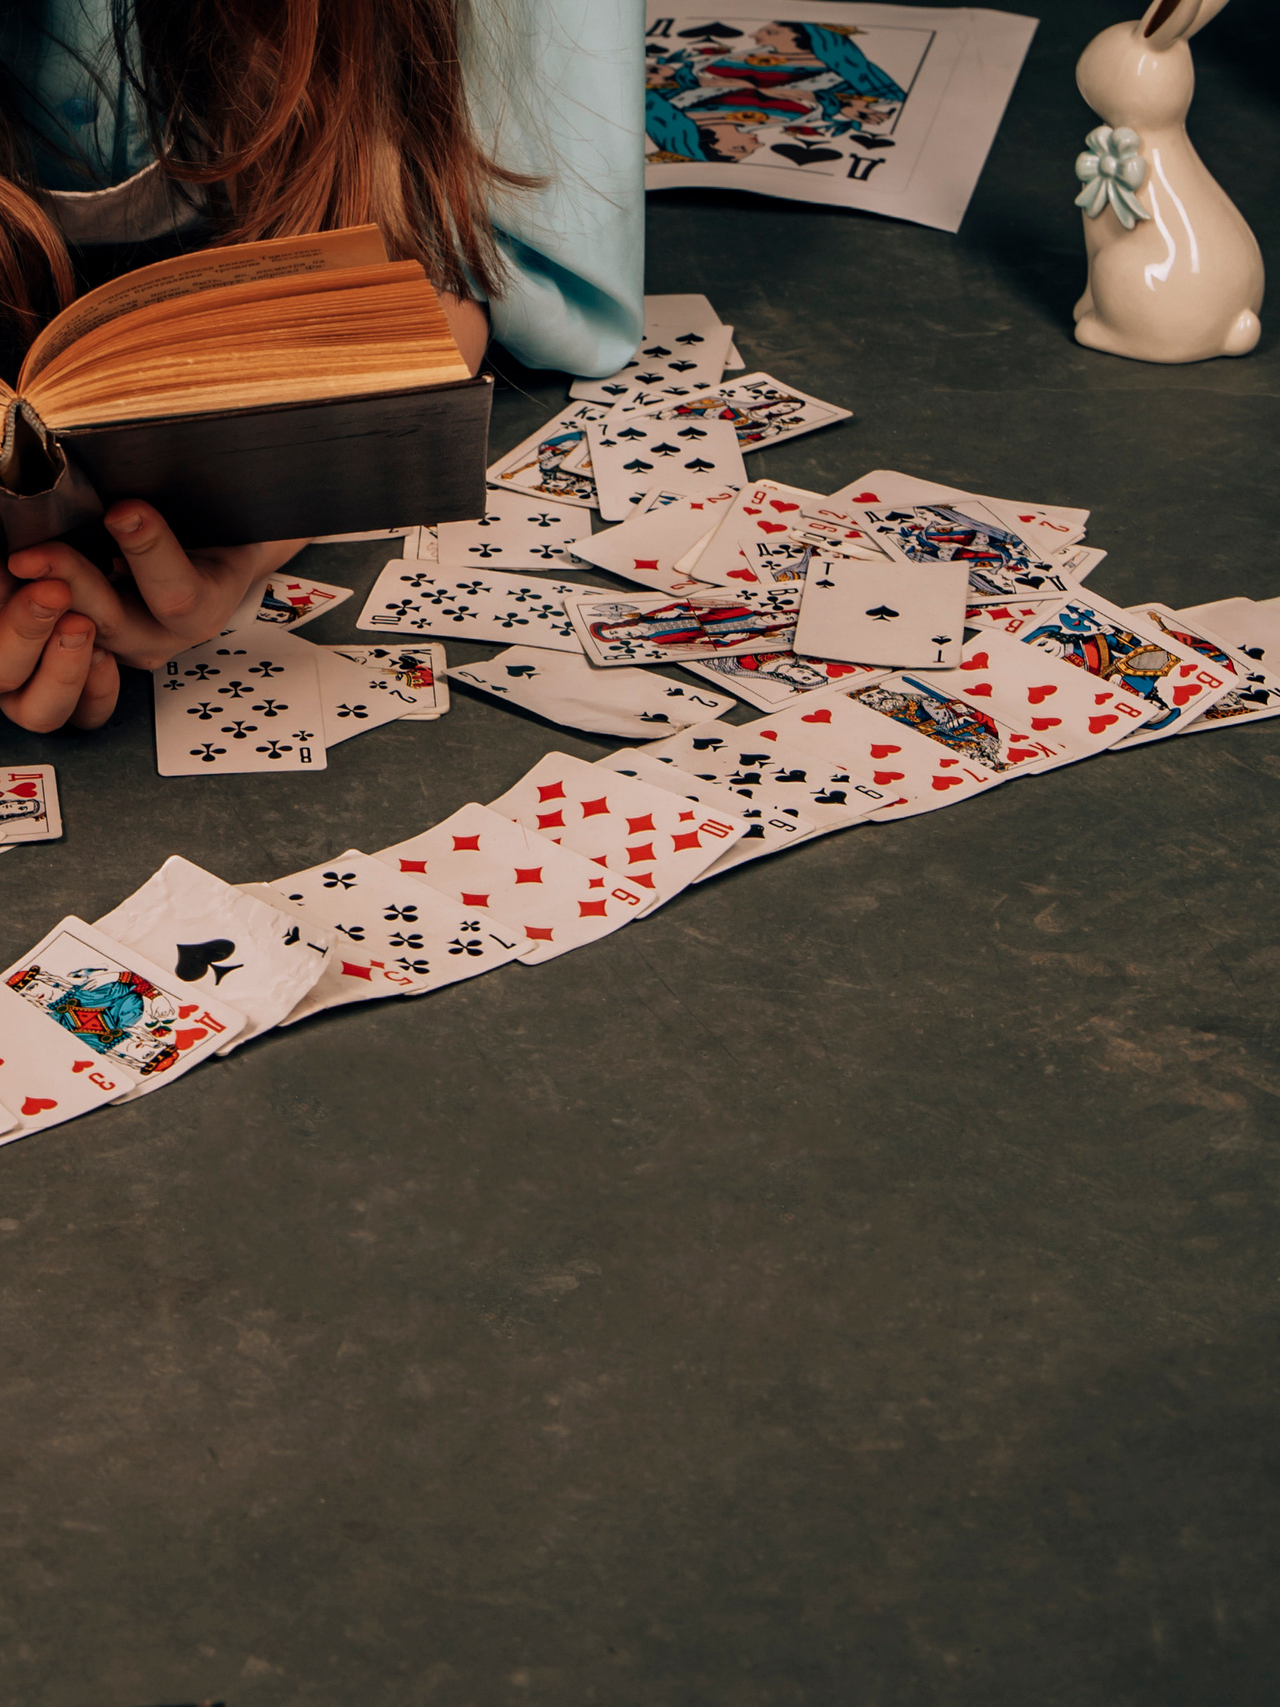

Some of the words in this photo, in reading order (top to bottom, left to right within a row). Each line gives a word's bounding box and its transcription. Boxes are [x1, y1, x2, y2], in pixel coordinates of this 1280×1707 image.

[646, 19, 674, 38] Д
[847, 154, 885, 181] Д
[741, 381, 768, 392] Д
[574, 406, 595, 419] К
[598, 424, 608, 436] 7
[707, 493, 732, 503] 2
[752, 491, 766, 504] 9
[817, 510, 847, 521] 2
[864, 511, 884, 523] Д
[1040, 521, 1069, 532] 2
[757, 543, 774, 557] Д
[823, 561, 835, 575] Т
[1046, 576, 1067, 591] Д
[305, 589, 336, 601] Д
[370, 614, 403, 625] 10
[932, 649, 946, 664] Т
[167, 662, 178, 675] 8
[458, 672, 486, 685] 2
[389, 690, 417, 703] 2
[689, 696, 718, 707] 2
[1113, 703, 1141, 720] 8
[300, 748, 311, 763] 8
[963, 769, 988, 782] 7
[699, 819, 734, 838] 10
[489, 934, 516, 949] 7
[307, 943, 328, 957] Т
[384, 969, 412, 985] 5
[192, 1010, 226, 1035] Д
[89, 1073, 115, 1090] 3
